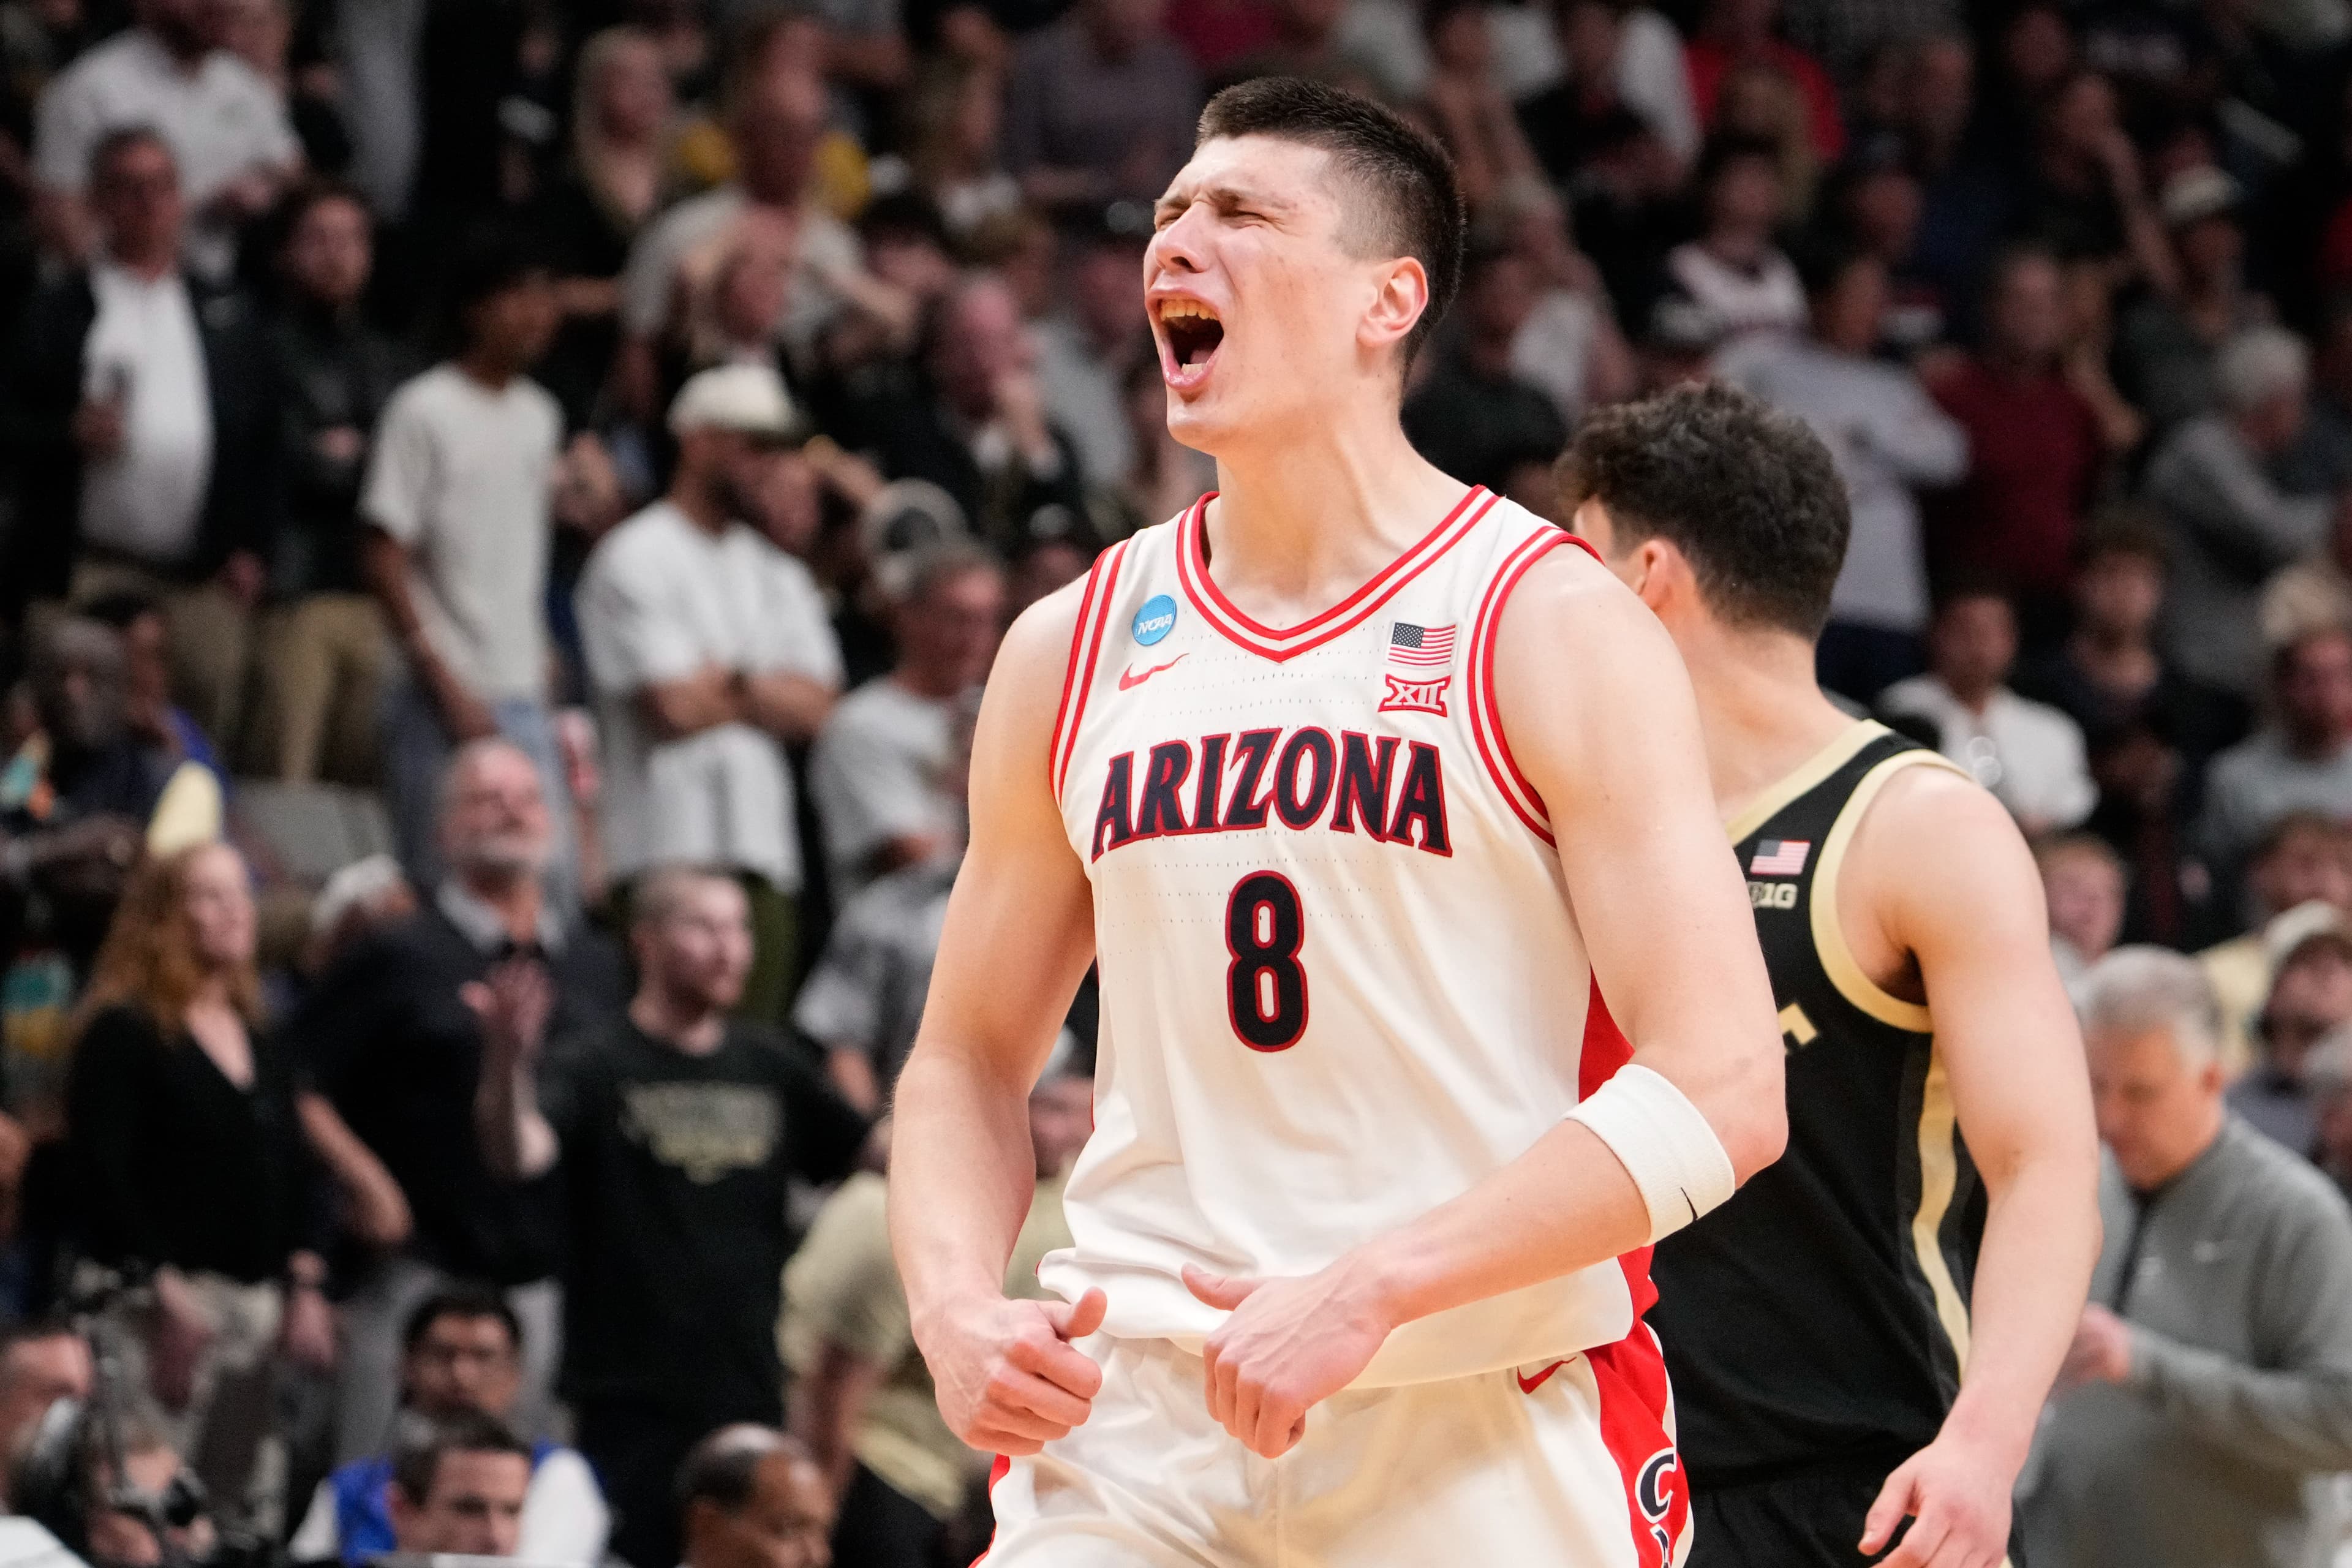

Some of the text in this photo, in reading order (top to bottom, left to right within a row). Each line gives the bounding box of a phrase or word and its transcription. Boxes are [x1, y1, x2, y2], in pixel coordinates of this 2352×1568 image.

[1137, 614, 1173, 635] NCAA
[1382, 677, 1447, 712] XII
[1091, 727, 1453, 864] ARIZONA
[1225, 870, 1309, 1053] 8
